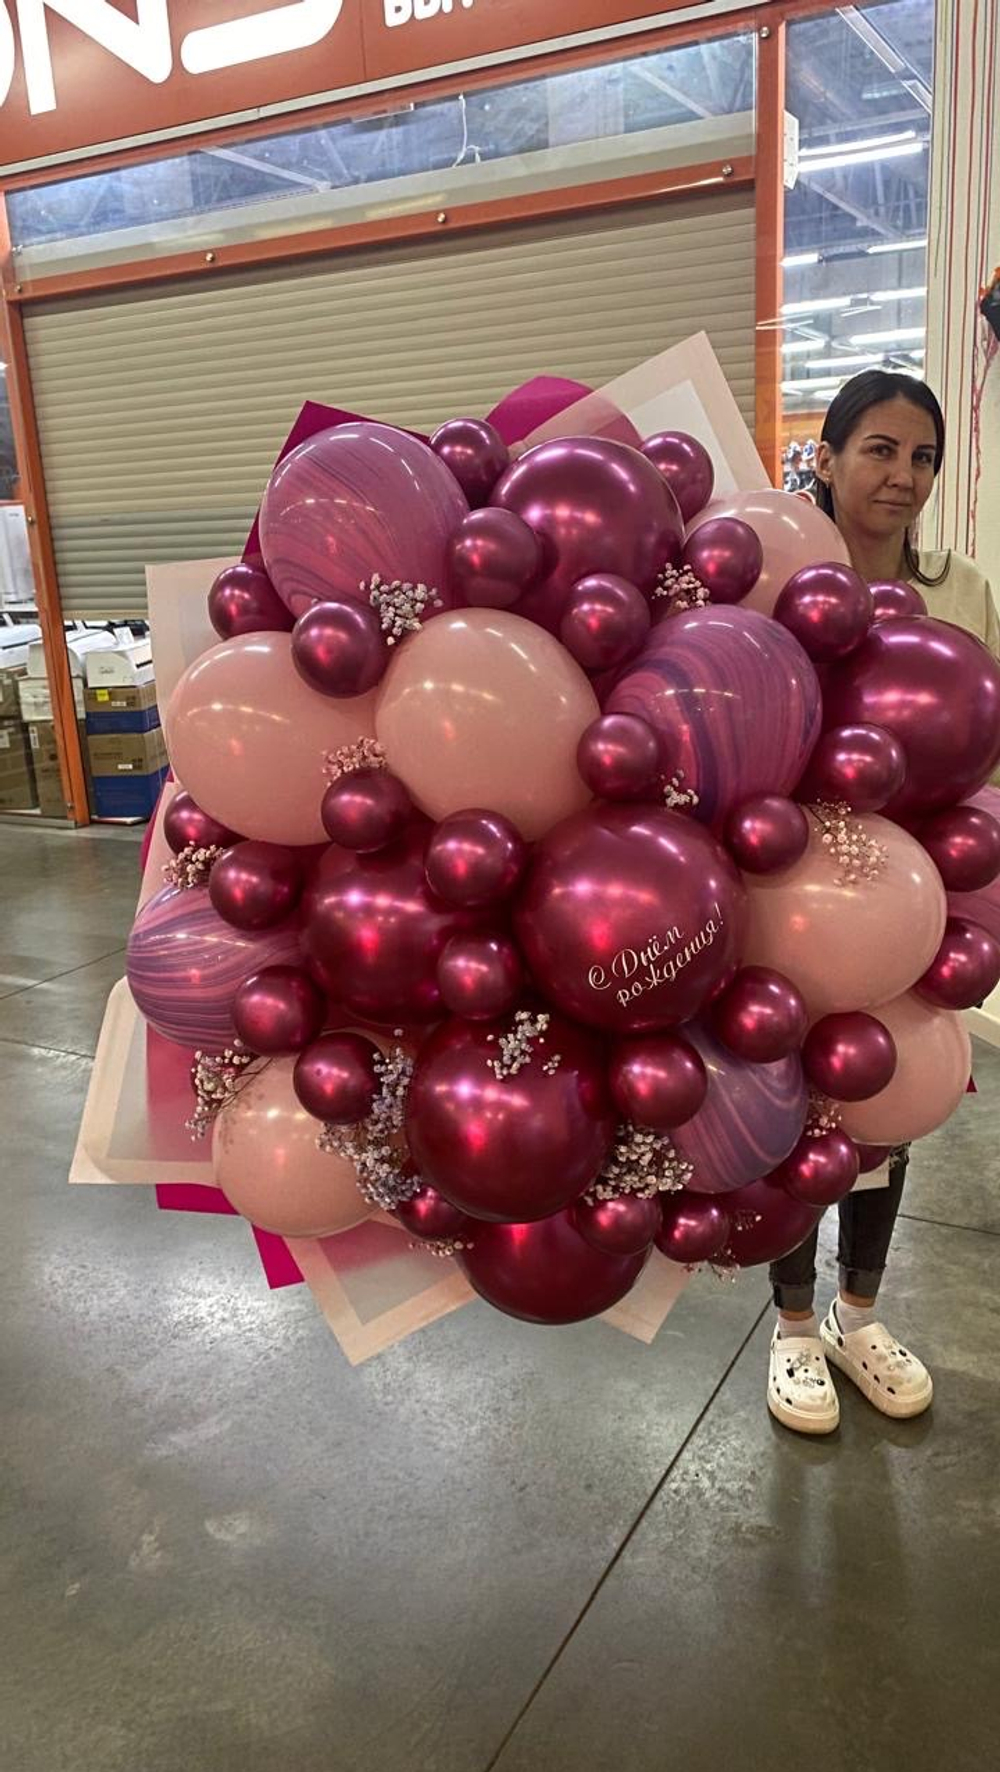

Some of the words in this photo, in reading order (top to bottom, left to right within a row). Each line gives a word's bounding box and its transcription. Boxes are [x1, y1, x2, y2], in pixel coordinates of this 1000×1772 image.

[588, 965, 612, 990] С
[611, 926, 685, 978] Днём
[616, 901, 724, 1007] рождения!
